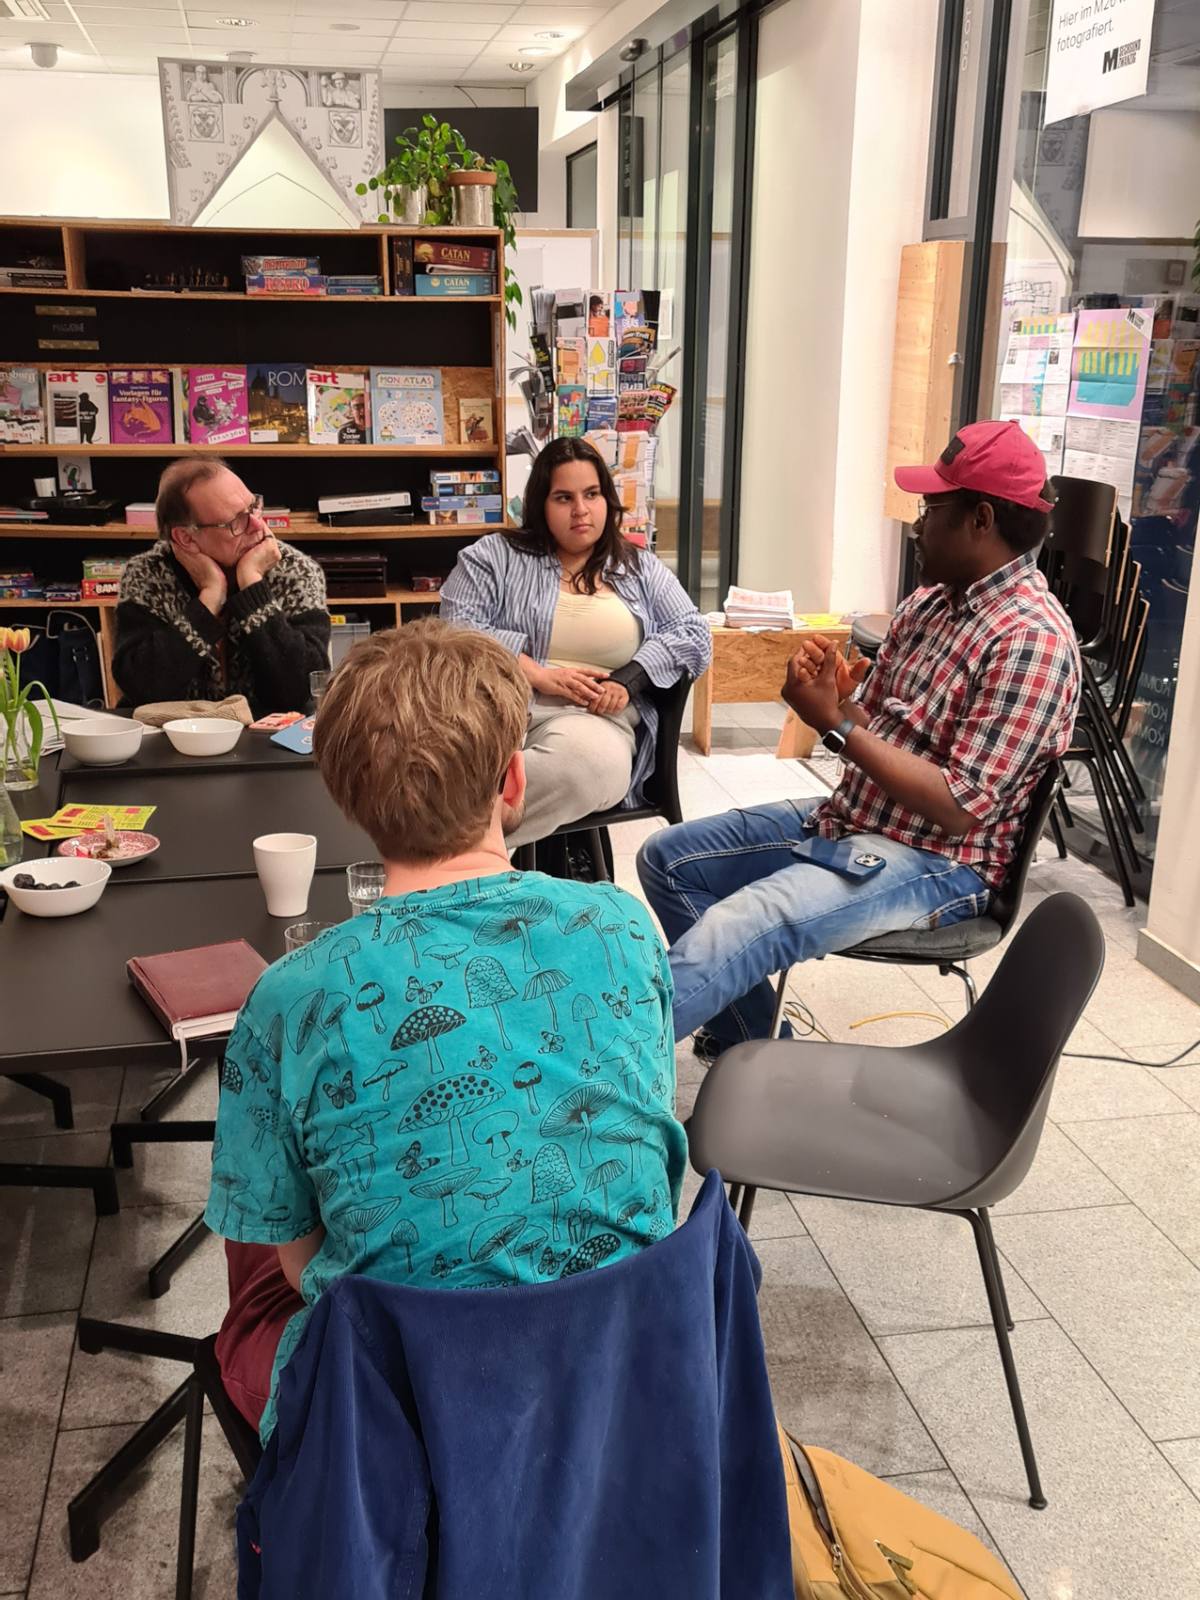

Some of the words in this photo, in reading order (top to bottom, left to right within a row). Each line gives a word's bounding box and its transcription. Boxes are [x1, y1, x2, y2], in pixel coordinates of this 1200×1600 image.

[1059, 11, 1078, 29] Hier
[1080, 6, 1092, 20] im
[1057, 18, 1114, 53] fotografiert.
[1102, 47, 1119, 75] M
[441, 248, 471, 261] CATAN
[264, 275, 310, 292] RISIKO
[444, 277, 470, 287] CATAN
[1, 370, 36, 384] nsburg
[48, 371, 79, 384] art
[308, 372, 340, 385] art
[380, 376, 400, 384] MON
[404, 377, 432, 385] ATLAS
